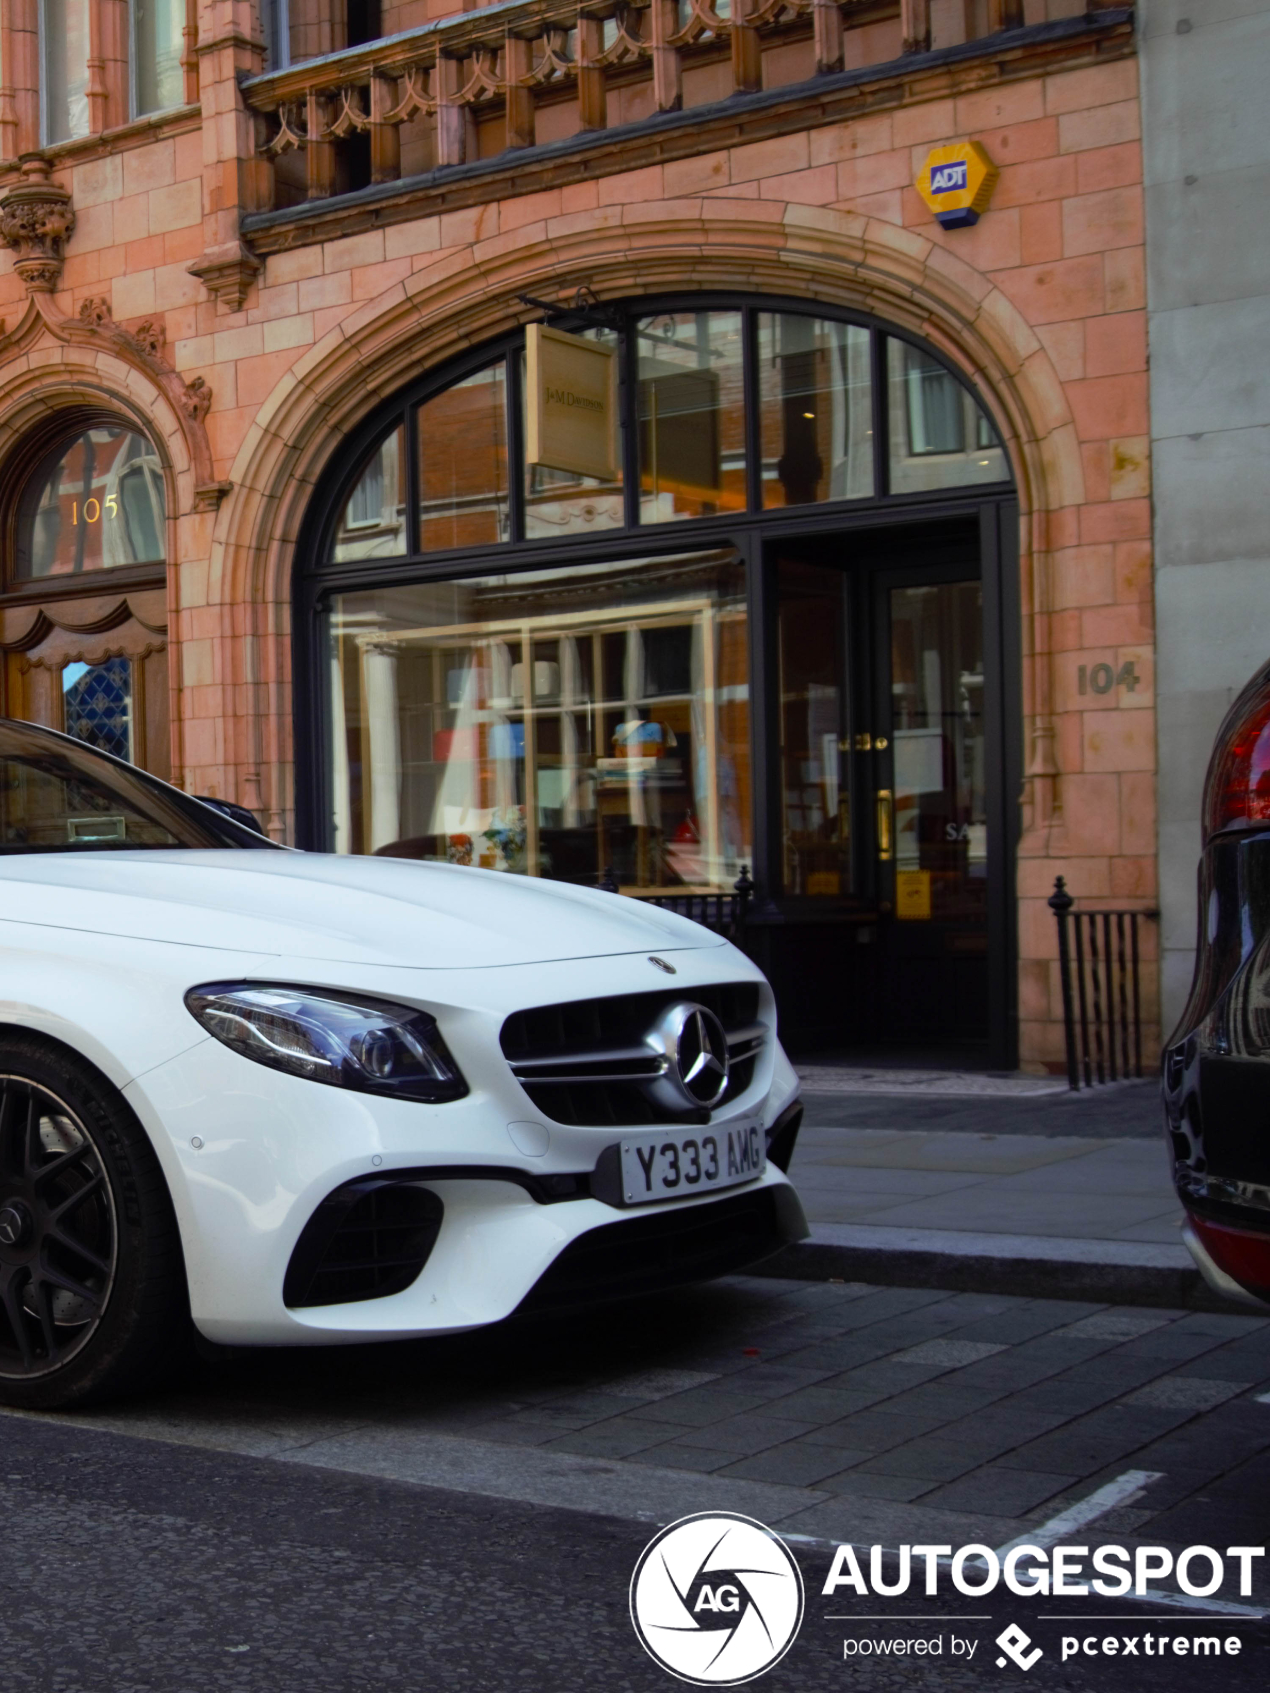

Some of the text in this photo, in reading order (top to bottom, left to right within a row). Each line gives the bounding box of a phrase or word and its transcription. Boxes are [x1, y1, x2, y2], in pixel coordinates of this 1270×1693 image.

[931, 165, 967, 190] ADT
[545, 387, 565, 405] J&M
[72, 493, 118, 525] 105
[1078, 661, 1141, 696] 104
[636, 1126, 760, 1192] Y333 AMG
